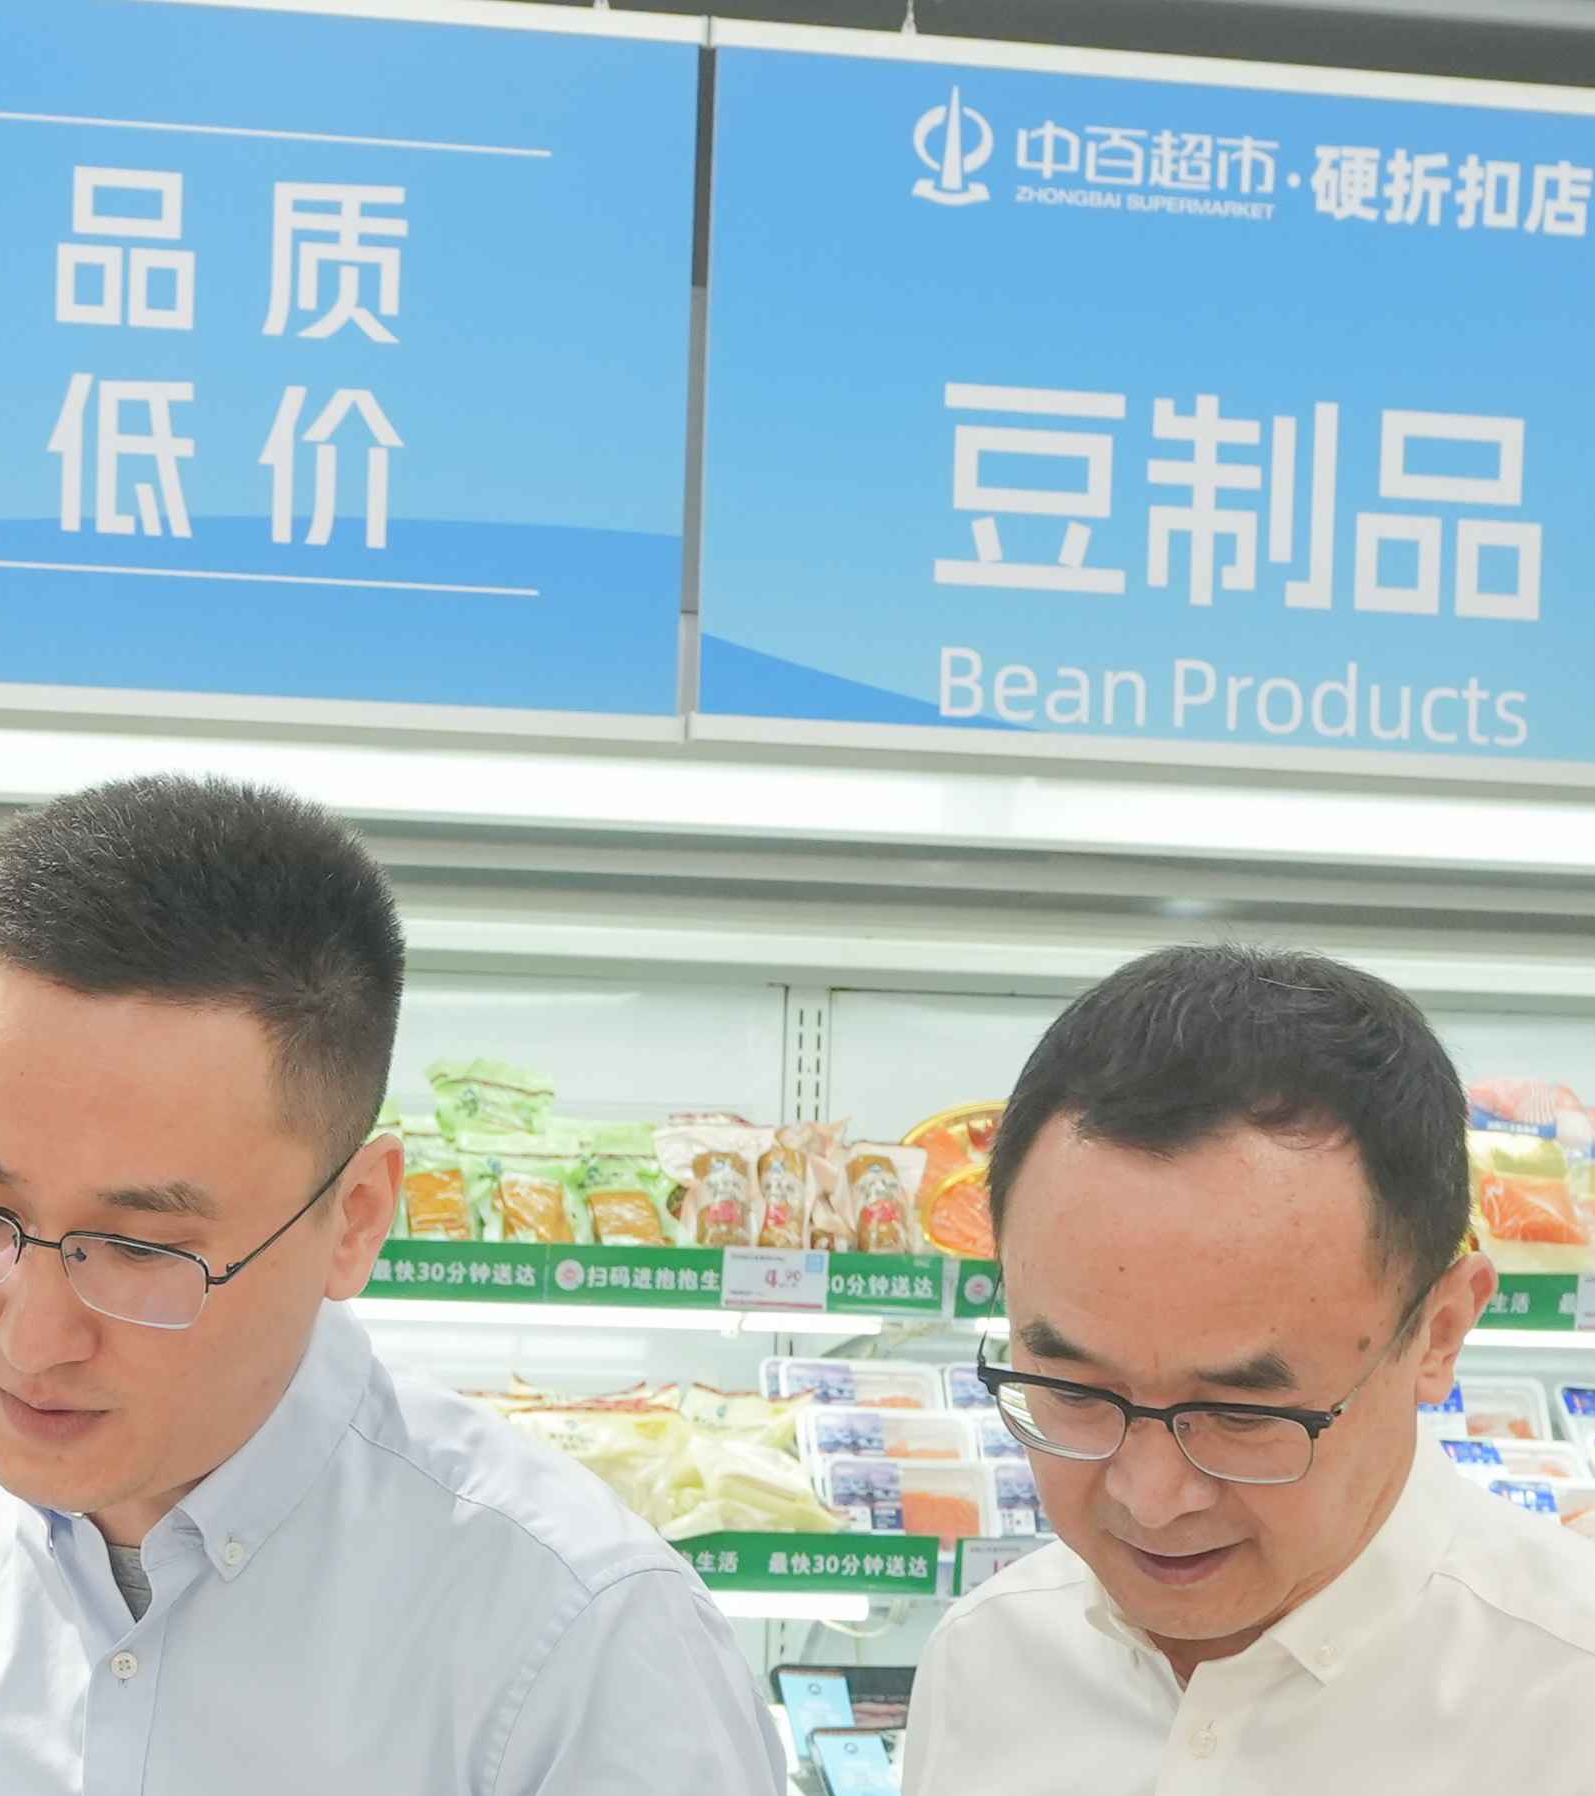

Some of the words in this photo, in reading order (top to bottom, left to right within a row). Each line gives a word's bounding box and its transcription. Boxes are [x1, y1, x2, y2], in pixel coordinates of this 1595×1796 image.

[1015, 184, 1121, 208] ZHONGBAI
[1127, 192, 1275, 221] SUPERMARKET
[934, 383, 1542, 621] 豆制品
[938, 646, 1147, 730] Bean
[1173, 658, 1529, 749] Products
[372, 1259, 536, 1286] 最快30分钟送达
[768, 1552, 929, 1578] 最快30分钟送达
